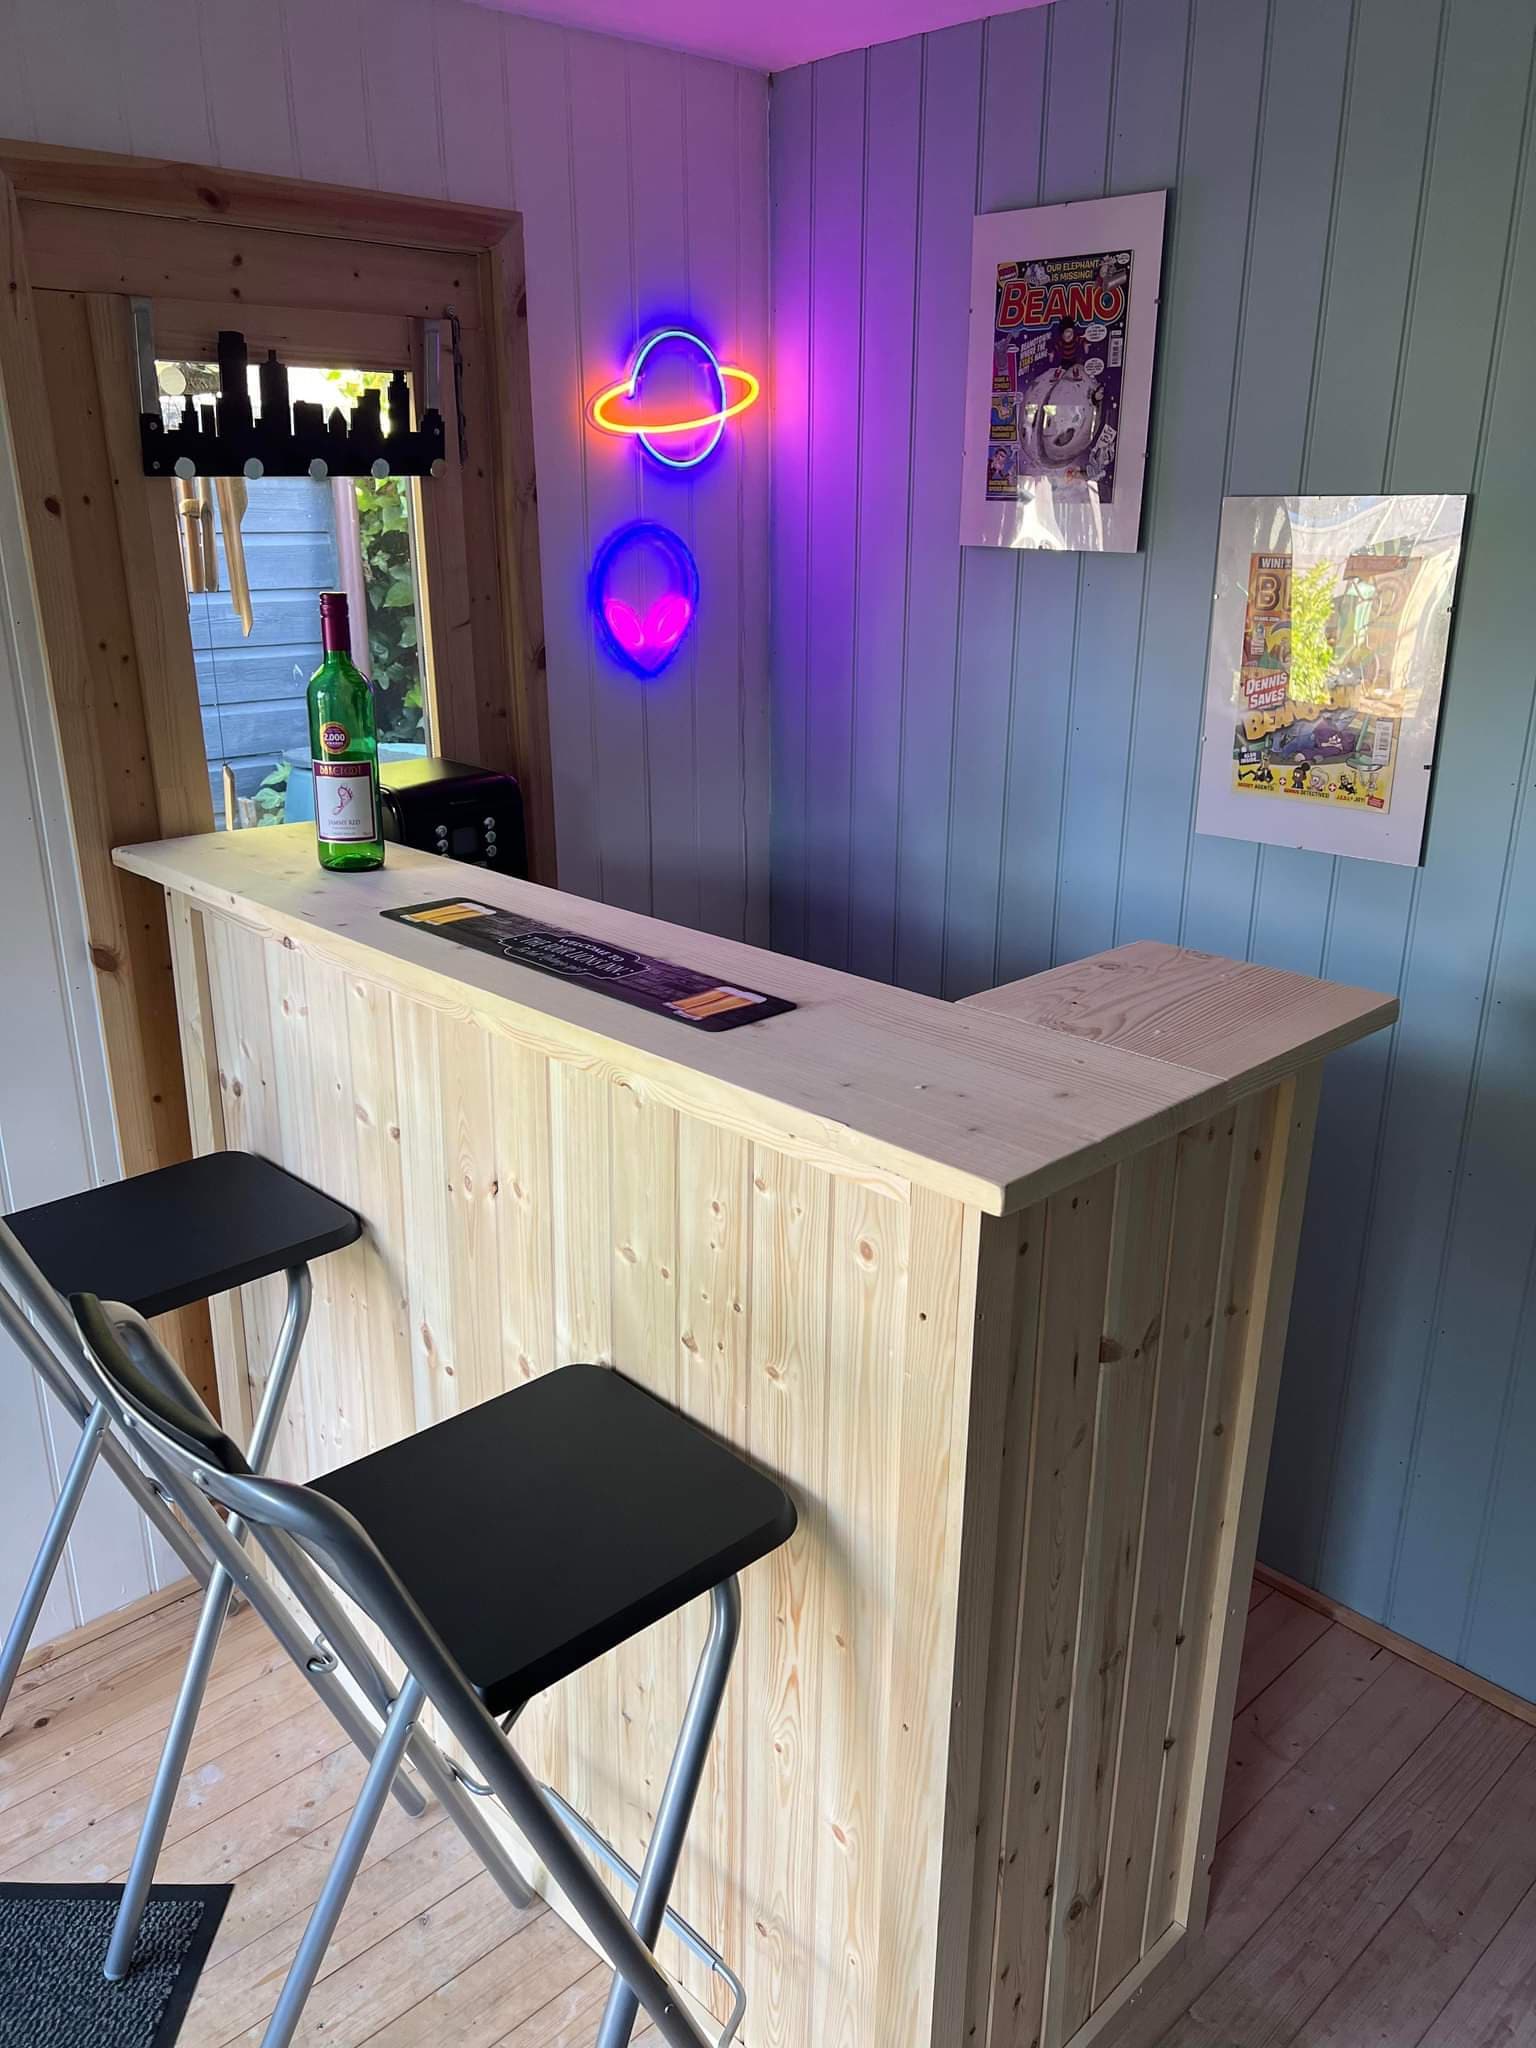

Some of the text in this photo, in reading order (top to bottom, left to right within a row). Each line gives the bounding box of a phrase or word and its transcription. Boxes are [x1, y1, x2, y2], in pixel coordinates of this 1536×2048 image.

[1046, 259, 1100, 272] OUR ELEPHANT
[1051, 270, 1093, 281] IS MISSING!
[998, 281, 1123, 327] BEANO
[1261, 558, 1284, 569] WIN!
[1246, 672, 1288, 694] DENNIS
[1249, 688, 1285, 708] SAVES
[348, 818, 361, 826] RED
[559, 938, 609, 957] WELCOME
[607, 954, 625, 962] TO
